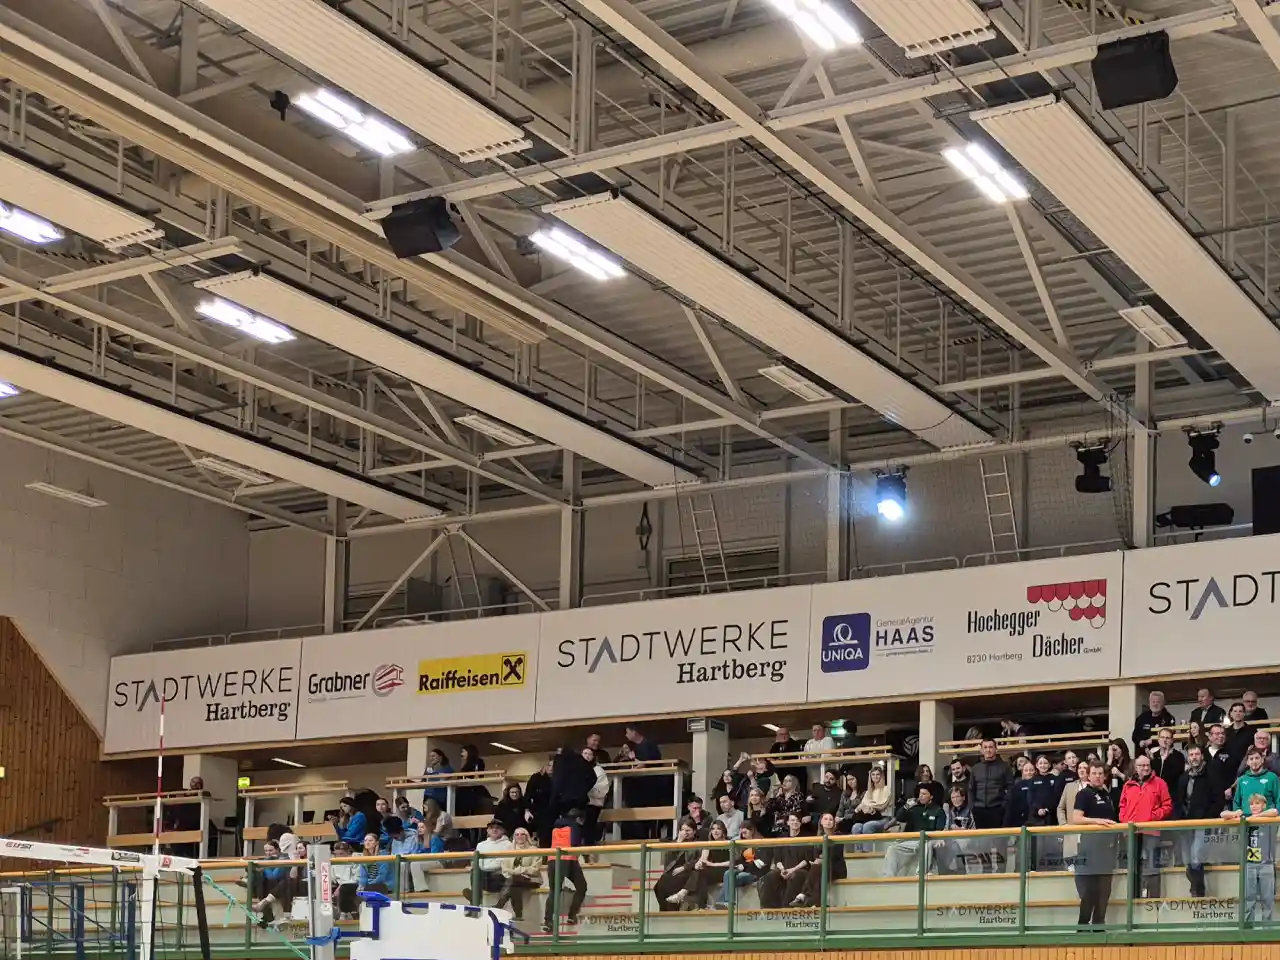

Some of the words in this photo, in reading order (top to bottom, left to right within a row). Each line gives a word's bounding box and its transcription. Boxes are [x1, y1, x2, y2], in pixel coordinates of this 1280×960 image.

[876, 615, 935, 627] GeneralAgentur
[967, 608, 1041, 637] Hochegger
[875, 625, 934, 646] HAAS
[557, 620, 788, 673] STADTWERKE
[1032, 632, 1084, 658] Dächer
[822, 647, 864, 662] UNIQA
[966, 654, 987, 664] 8230
[989, 652, 1023, 662] Hartberg
[676, 659, 787, 684] Hartberg
[308, 671, 370, 694] Grabner
[419, 669, 500, 692] Raiffeisen
[114, 667, 294, 712] STADTWERKE
[205, 701, 291, 721] Hartberg
[936, 904, 1017, 916] STADTWERKE
[1145, 898, 1235, 911] STADTWERKE
[577, 914, 640, 925] TADTWERKE
[747, 910, 820, 921] STADTWERKE
[979, 915, 1016, 925] Hartberg
[1193, 910, 1234, 920] Hartberg
[607, 924, 640, 933] Hartberg
[785, 920, 820, 929] Hartberg
